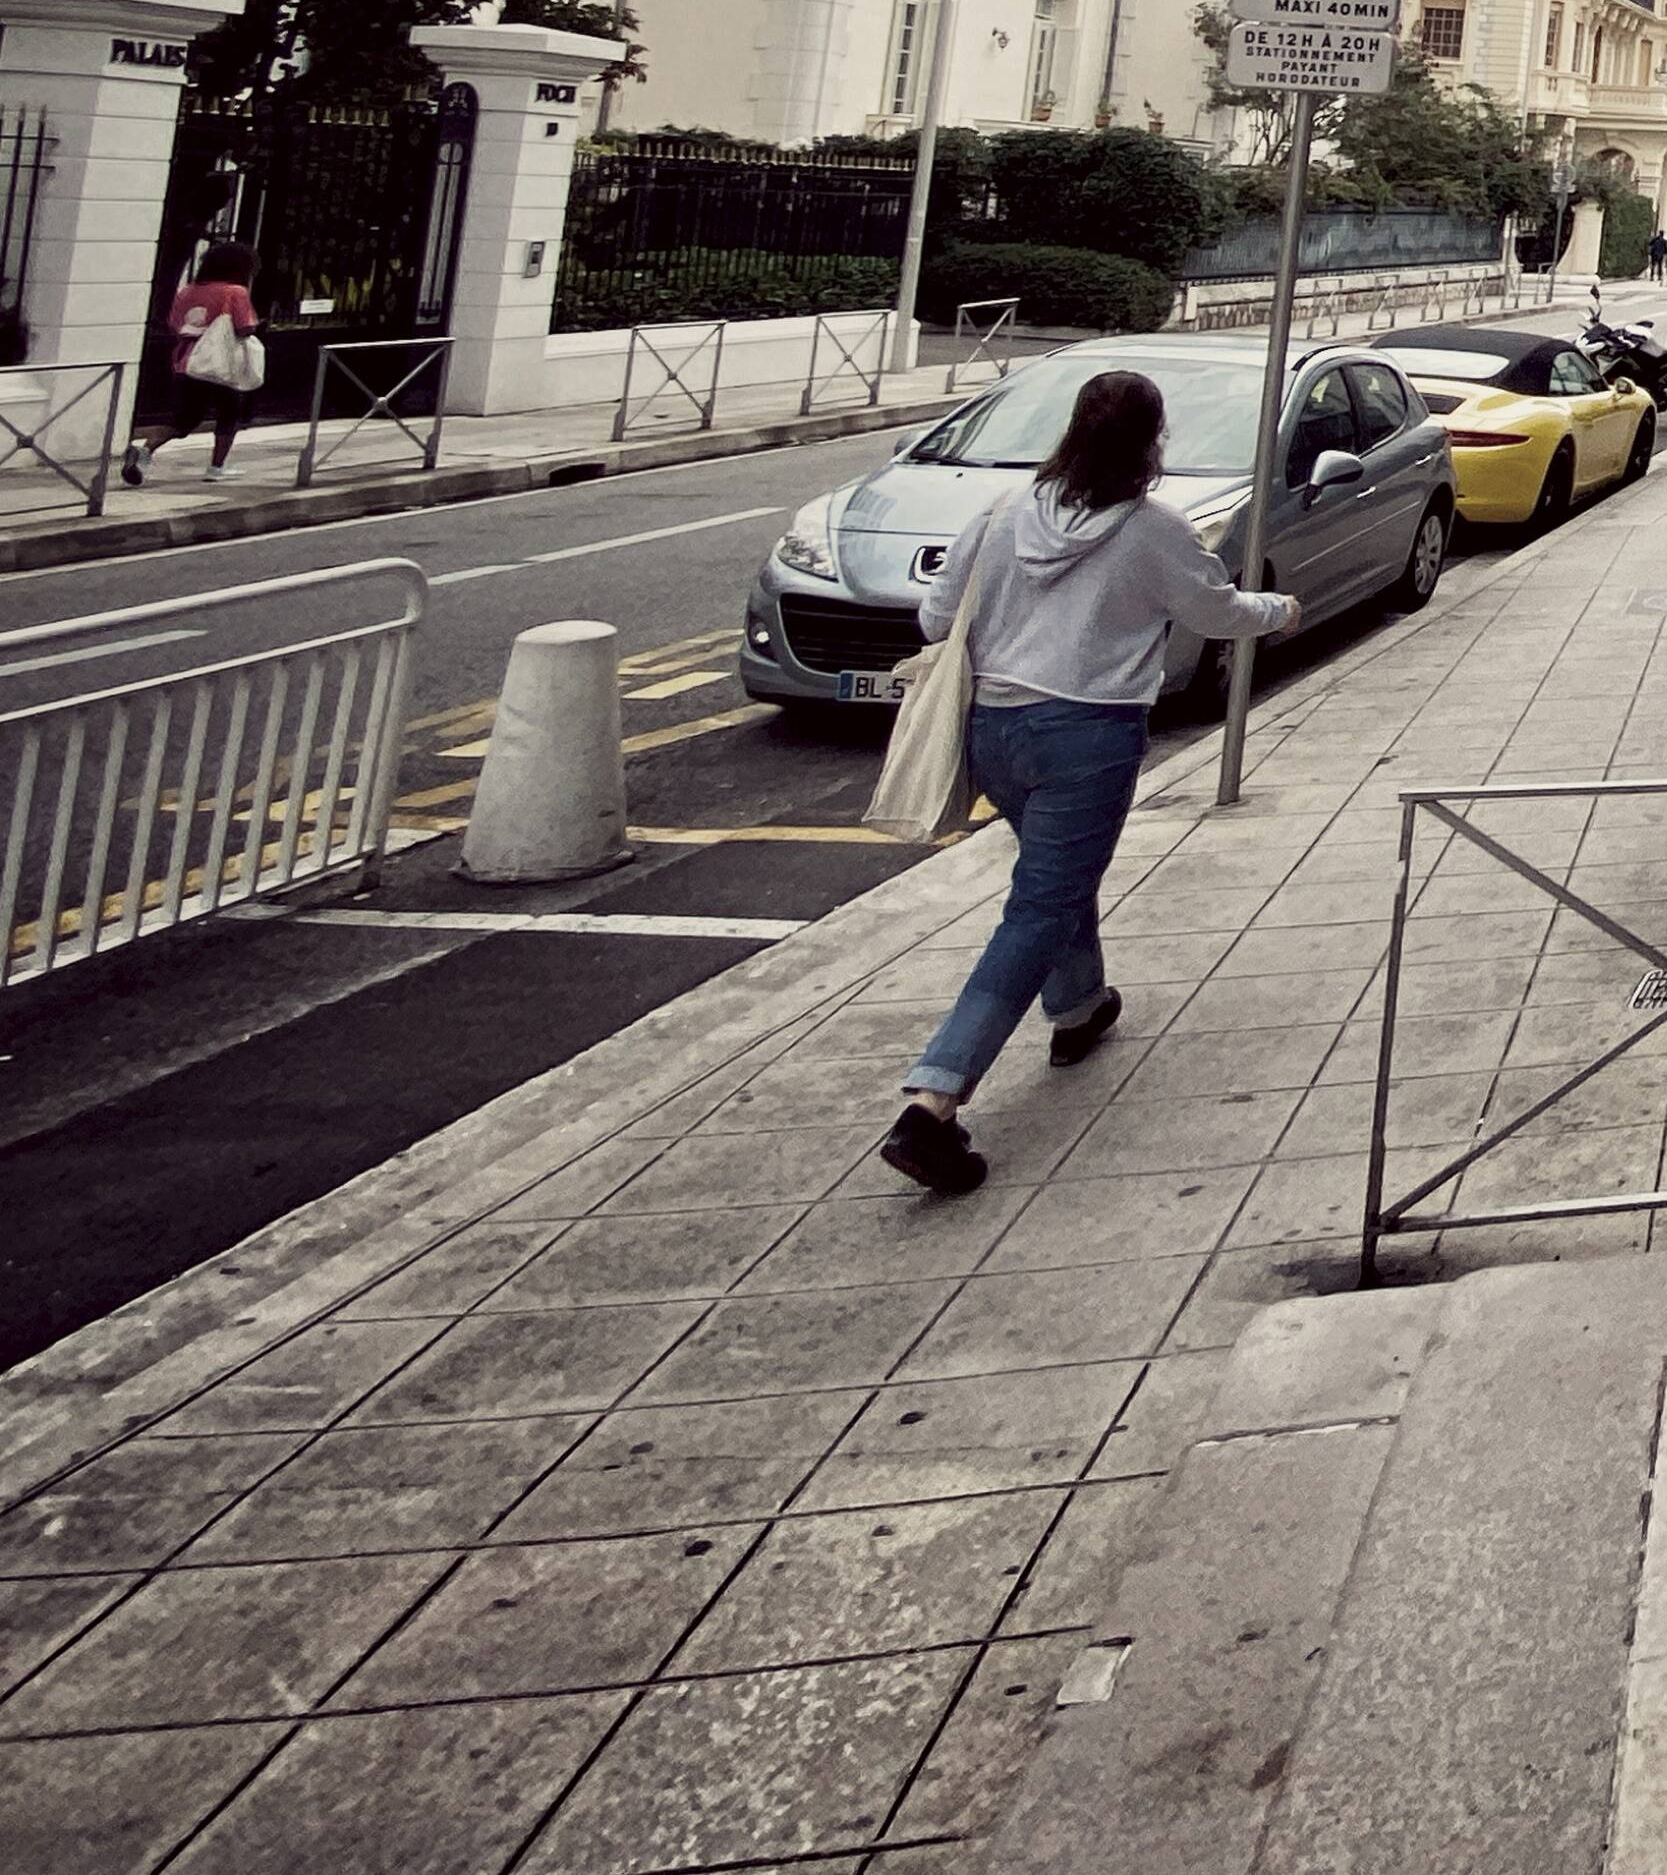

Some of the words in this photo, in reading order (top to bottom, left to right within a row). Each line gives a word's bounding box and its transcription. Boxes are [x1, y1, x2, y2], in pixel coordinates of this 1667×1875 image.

[1244, 31, 1268, 44] DE
[1341, 36, 1380, 51] 20H
[1246, 46, 1376, 63] STATIONNEMENT
[1281, 61, 1338, 74] PAYANT
[1256, 72, 1360, 87] HORODATEUR
[855, 676, 914, 699] BL-5
